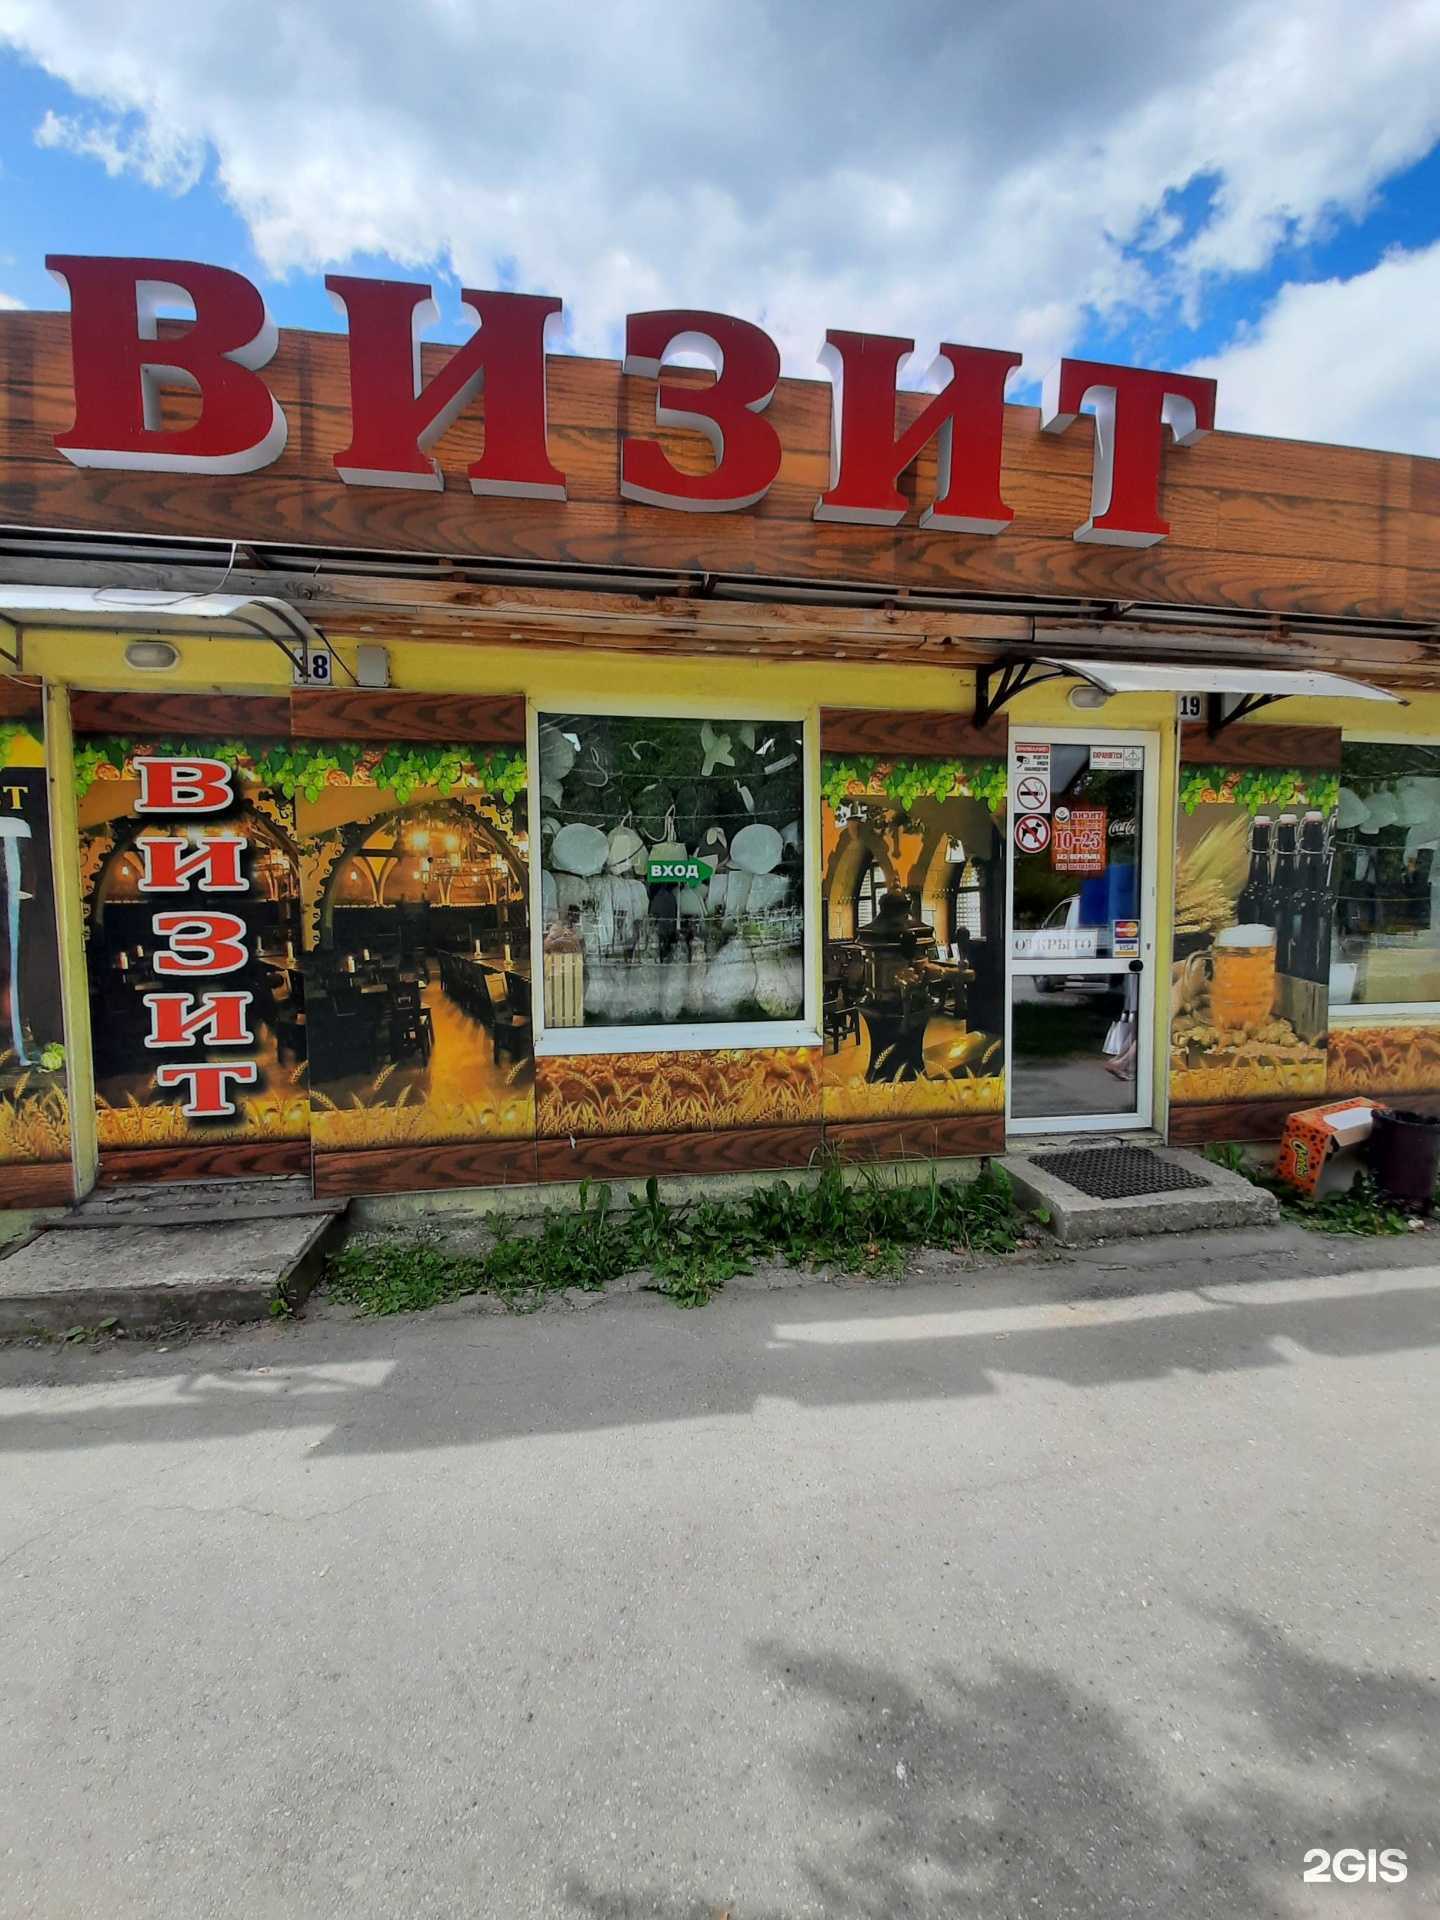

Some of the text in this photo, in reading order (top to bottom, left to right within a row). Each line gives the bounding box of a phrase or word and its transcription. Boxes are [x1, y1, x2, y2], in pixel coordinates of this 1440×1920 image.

[45, 254, 1217, 548] ВИЗИТ
[1180, 695, 1201, 716] 19
[133, 756, 258, 1117] ВИЗИТ
[651, 865, 699, 878] ВХОД
